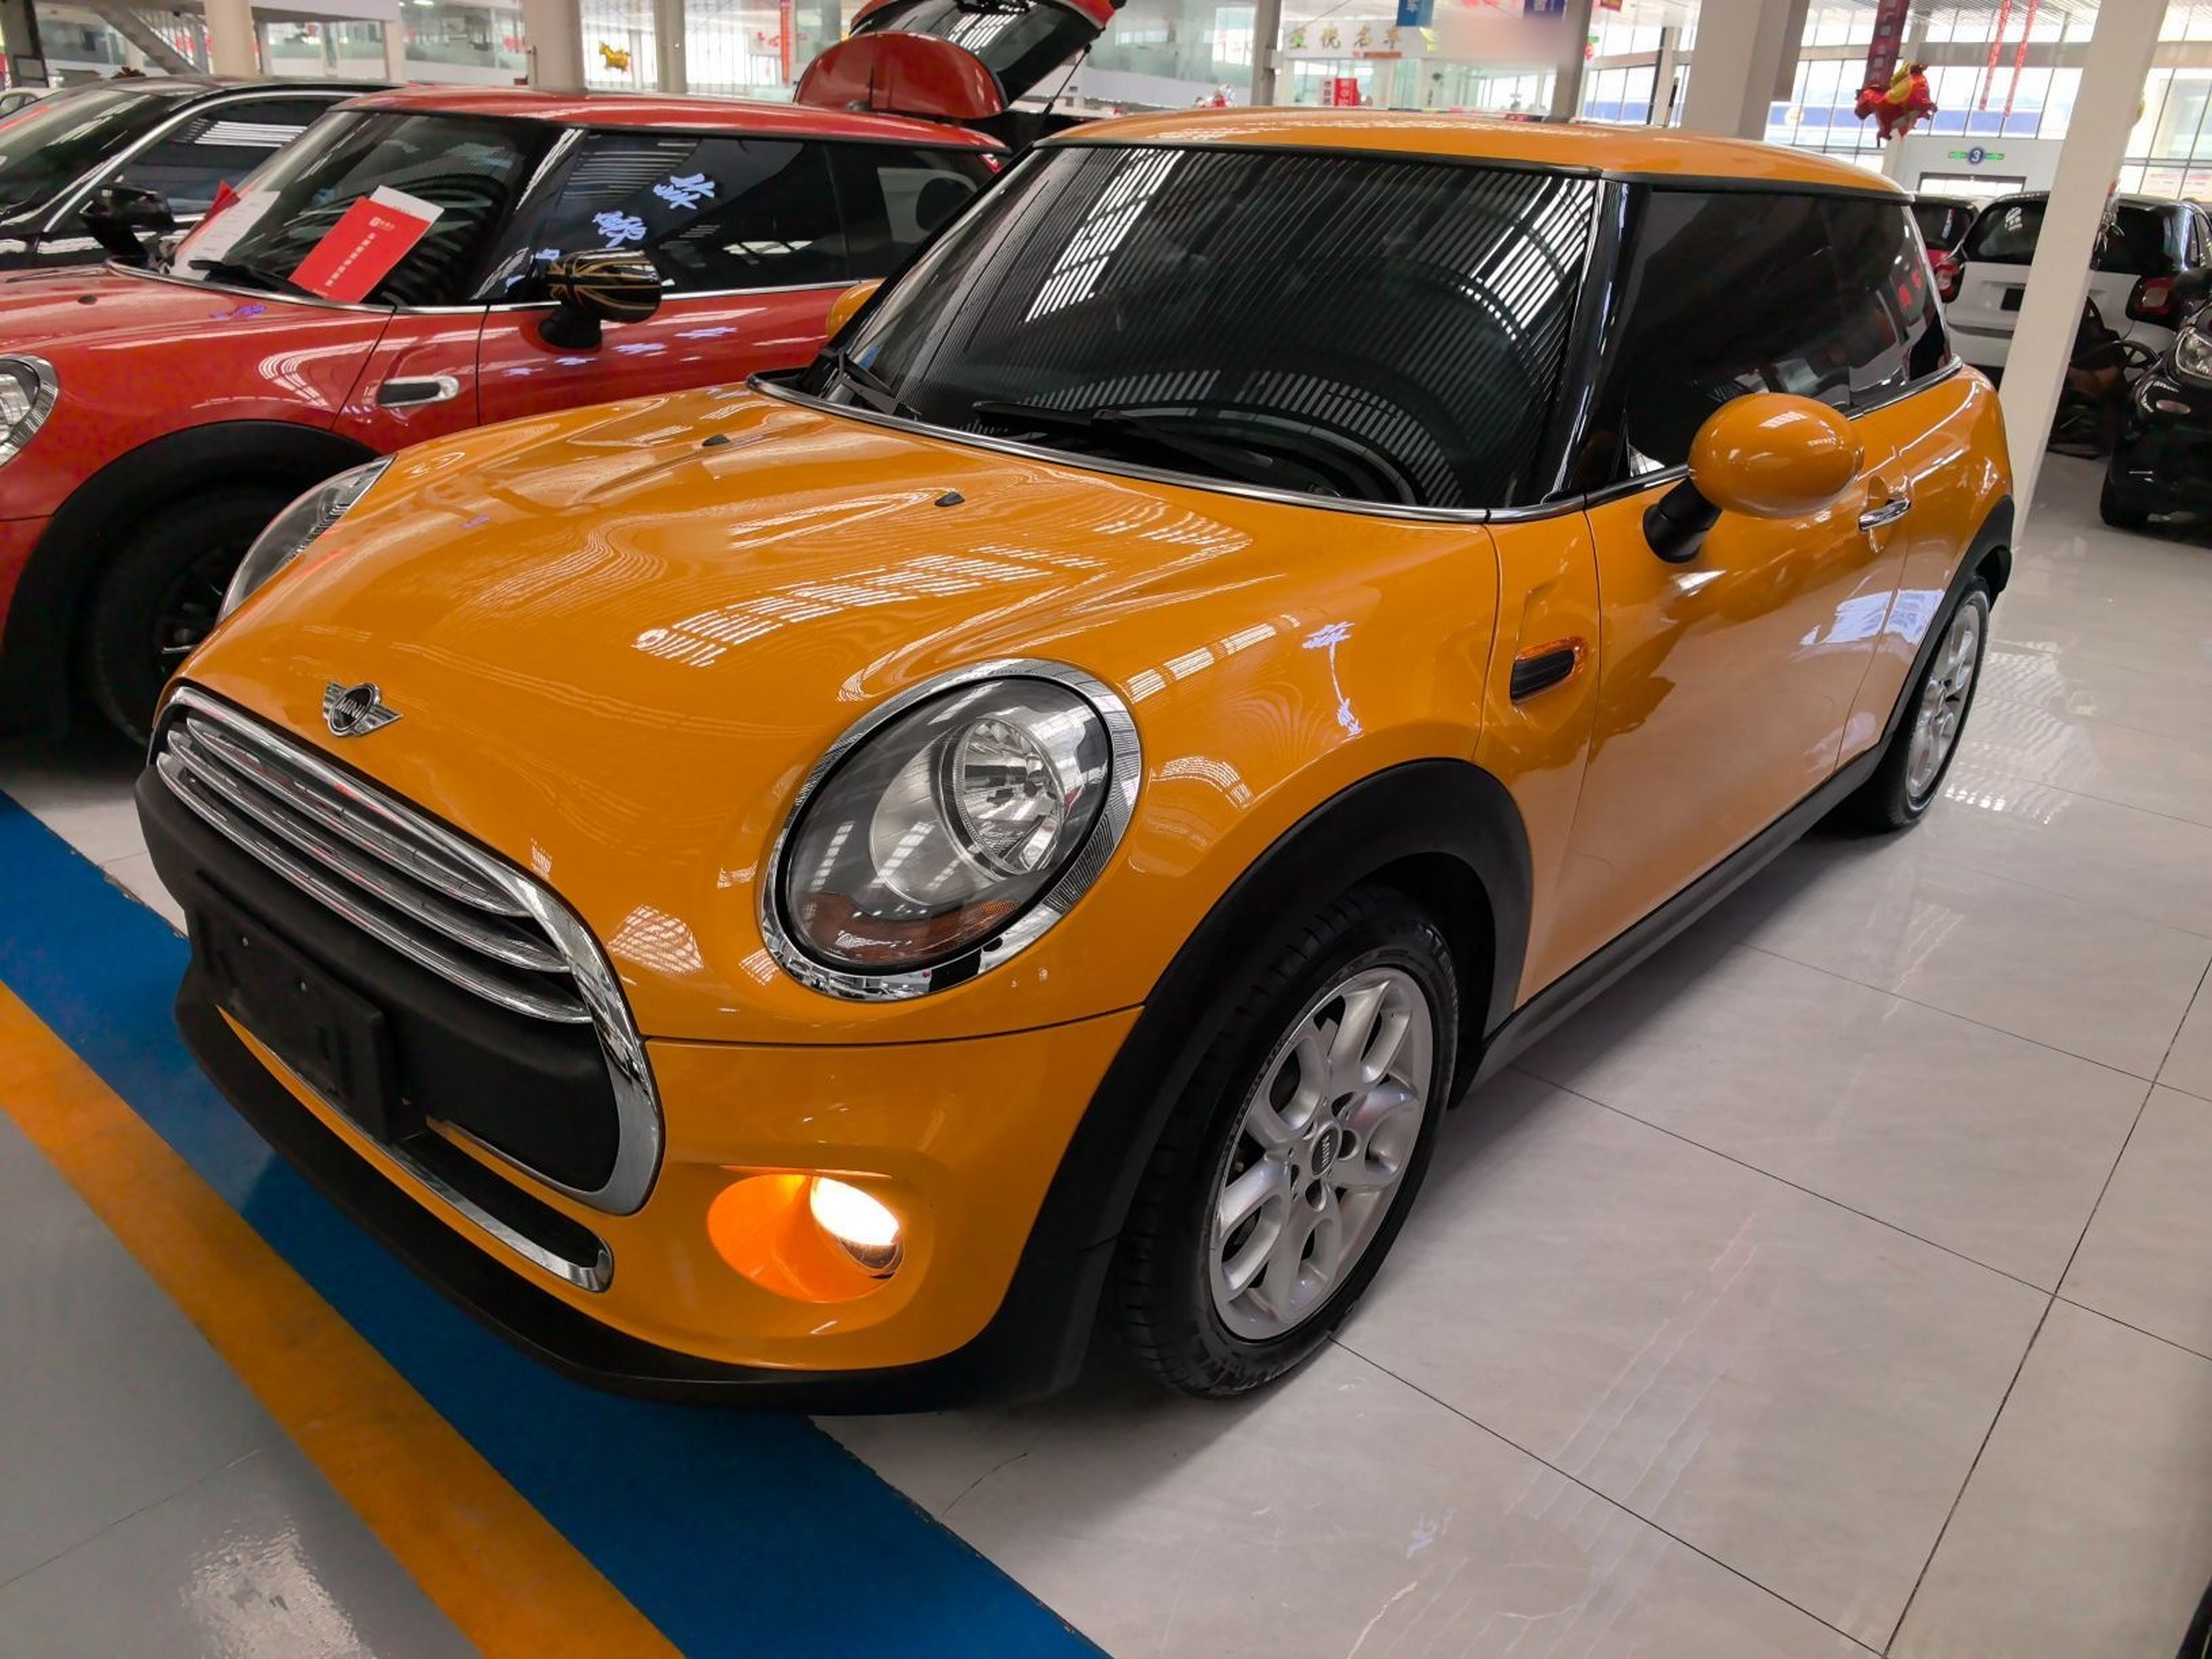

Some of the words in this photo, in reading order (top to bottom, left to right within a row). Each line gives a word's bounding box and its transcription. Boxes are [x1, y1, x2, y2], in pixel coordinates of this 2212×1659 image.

[1971, 150, 1981, 162] 3
[336, 697, 366, 719] MINI
[1321, 1135, 1331, 1168] MINI
